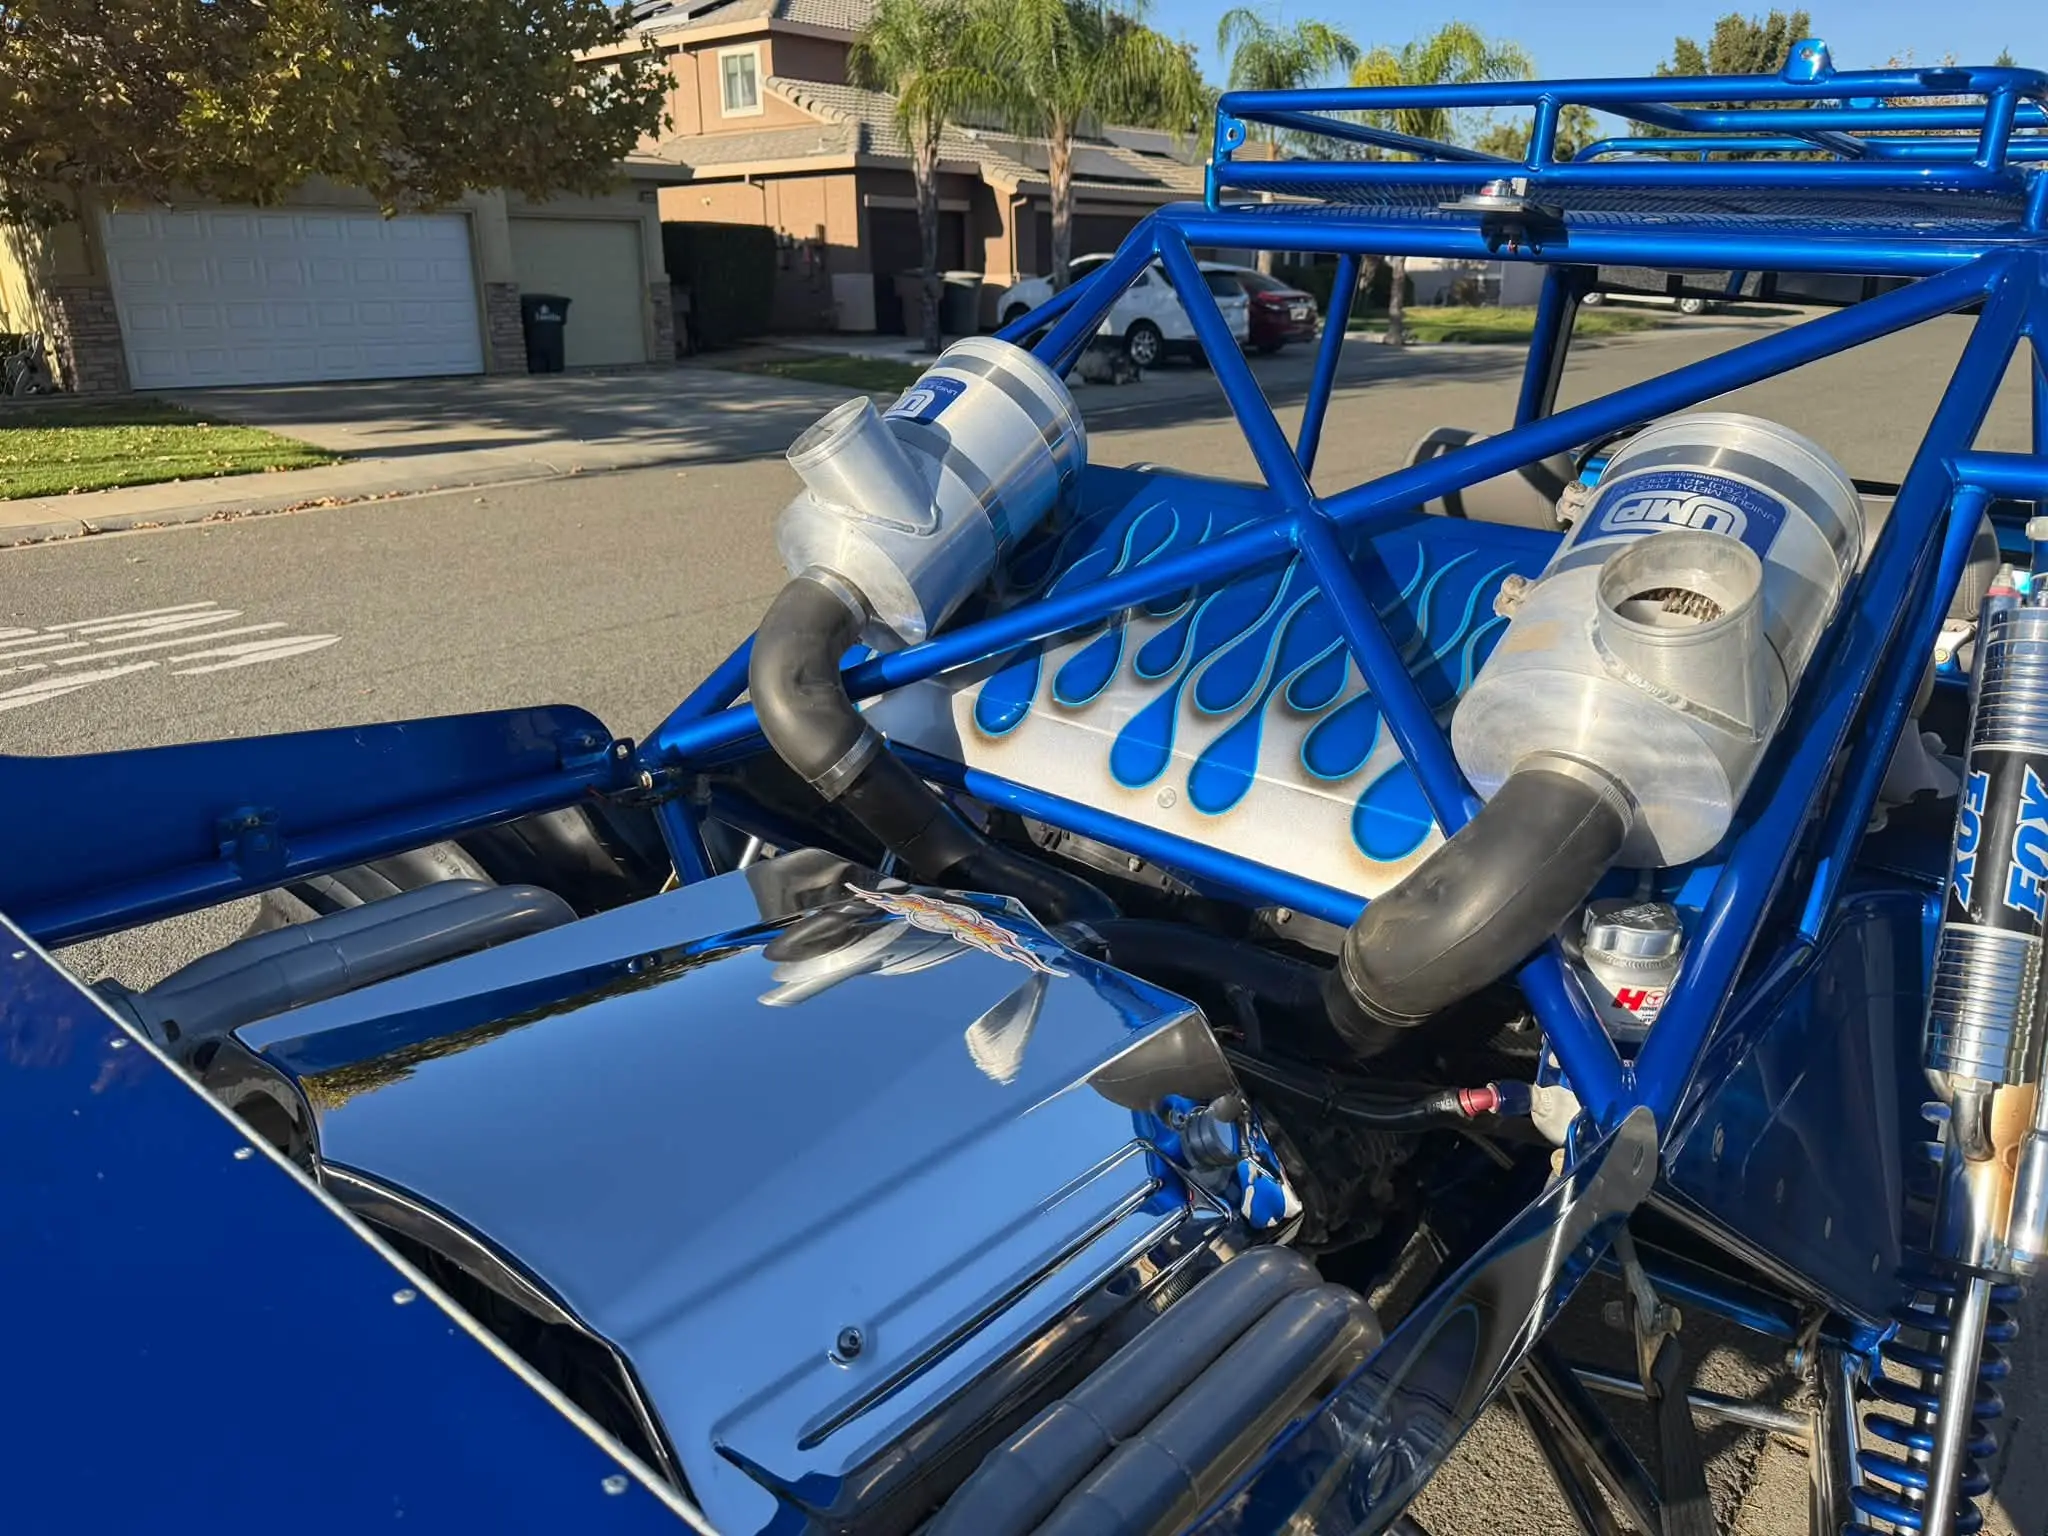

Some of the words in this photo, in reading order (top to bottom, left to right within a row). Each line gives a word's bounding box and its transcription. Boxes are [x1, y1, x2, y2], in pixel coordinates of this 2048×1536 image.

[1676, 482, 1722, 497] METAL
[1612, 499, 1734, 535] UMP
[1723, 493, 1777, 524] UNIQUE
[1951, 769, 1992, 913] FOX
[2002, 763, 2048, 926] FOX
